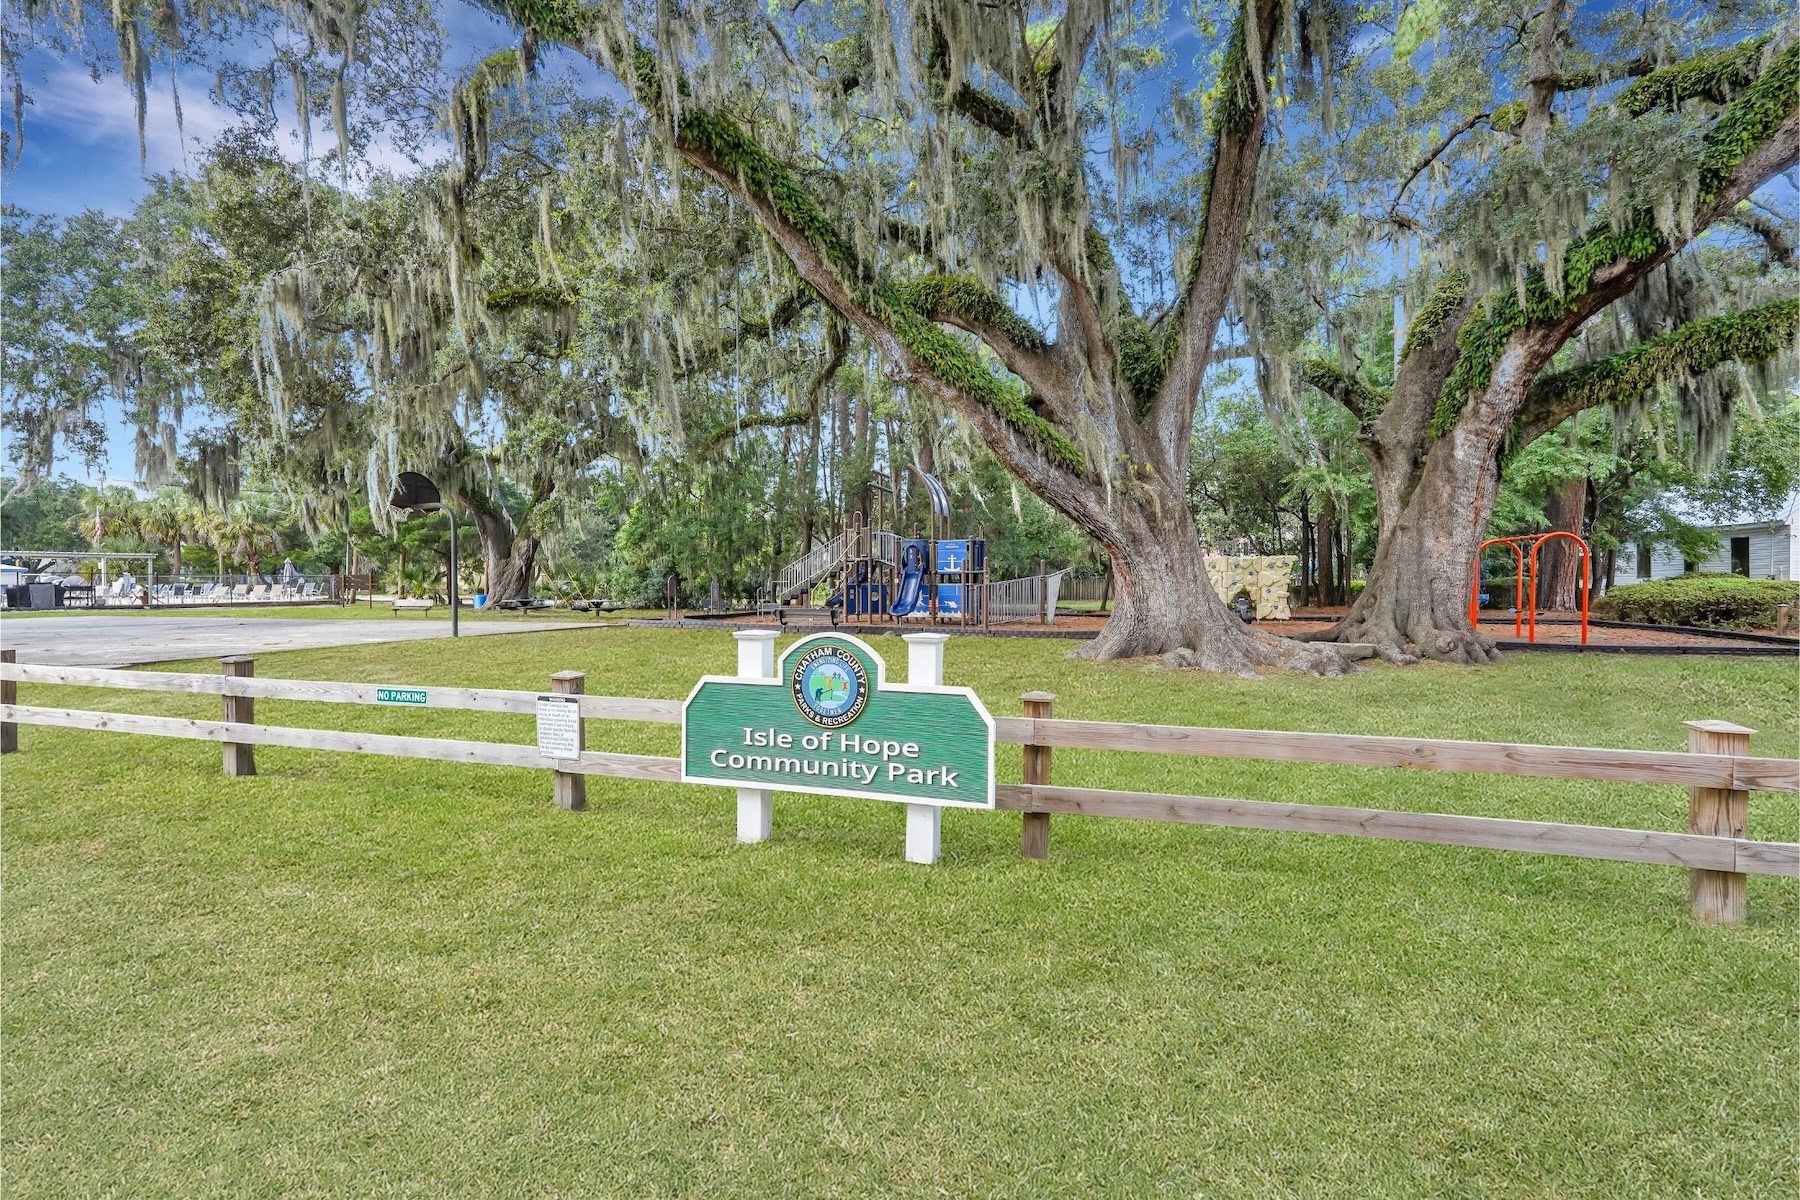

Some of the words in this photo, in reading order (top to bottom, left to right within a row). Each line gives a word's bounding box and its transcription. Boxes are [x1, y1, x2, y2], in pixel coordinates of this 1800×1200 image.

[795, 647, 833, 681] CHATHAM
[836, 649, 866, 684] COUNTY
[378, 690, 389, 701] NO
[391, 691, 426, 703] PARKING
[796, 693, 815, 719] PARKS
[822, 696, 864, 726] RECREATION
[743, 727, 794, 749] Isle
[801, 731, 834, 751] of
[840, 733, 921, 761] Hope
[710, 749, 879, 785] Community
[888, 762, 960, 788] Park
